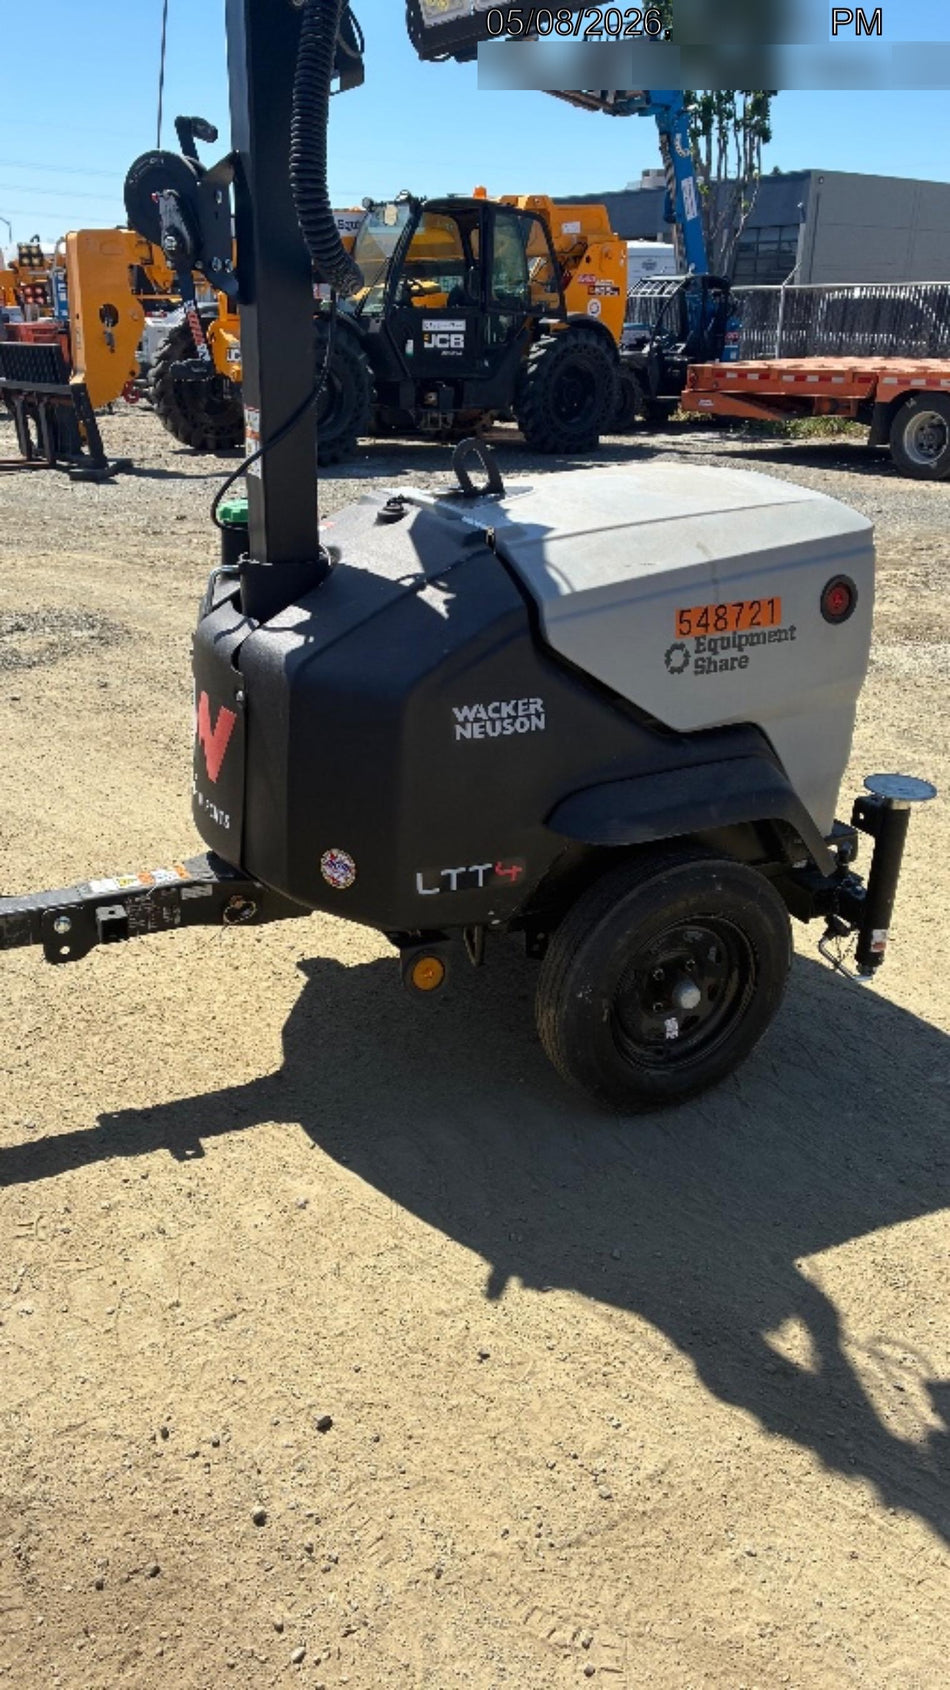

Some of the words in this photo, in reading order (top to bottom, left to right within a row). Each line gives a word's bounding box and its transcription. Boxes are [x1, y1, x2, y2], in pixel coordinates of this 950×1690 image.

[423, 333, 465, 348] JCB
[679, 598, 775, 636] 548721
[694, 624, 797, 656] Equipment
[693, 654, 750, 676] Share
[452, 698, 545, 722] WACKER
[455, 713, 545, 740] NEUSON
